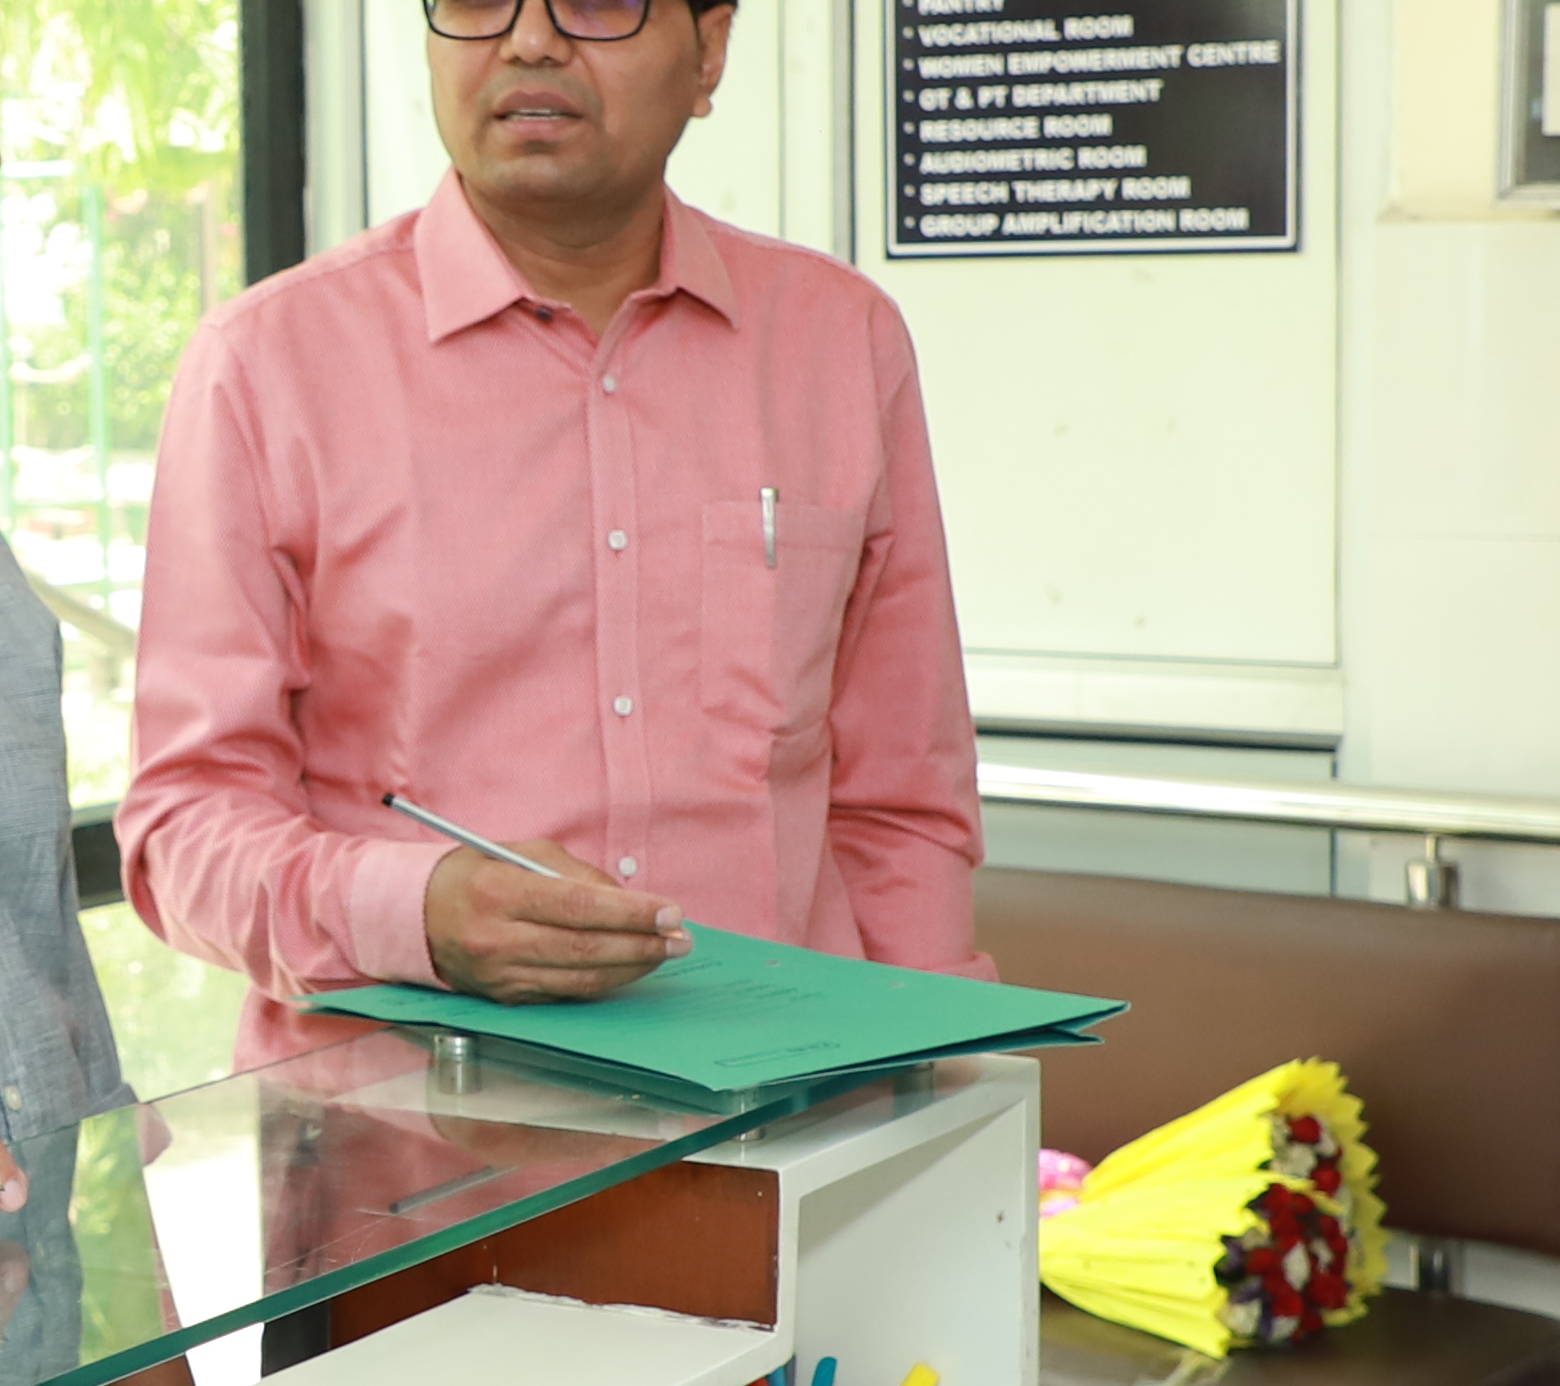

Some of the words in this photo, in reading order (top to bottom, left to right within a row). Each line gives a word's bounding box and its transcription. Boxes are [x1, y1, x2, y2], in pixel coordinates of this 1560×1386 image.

[917, 18, 1062, 48] VOCATIONAL
[1063, 14, 1134, 40] ROOM
[918, 53, 1005, 80] WOMEN
[1007, 44, 1183, 76] EMPOWERMENT
[1187, 40, 1281, 69] CENTRE
[918, 87, 952, 112] OT
[954, 86, 975, 110] &
[977, 84, 1010, 109] PT
[1012, 78, 1165, 109] DEPARTMENT
[919, 116, 1041, 144] RESOURCE
[1043, 113, 1114, 138] ROOM
[919, 148, 1075, 175] AUDIOMETRIC
[1077, 145, 1148, 170] ROOM
[919, 182, 1009, 207] SPEECH
[1011, 179, 1118, 205] THERAPY
[1121, 176, 1192, 201] ROOM
[919, 214, 1000, 238] GROUP
[1002, 210, 1177, 236] AMPLIFICATION
[1180, 208, 1250, 232] ROOM
